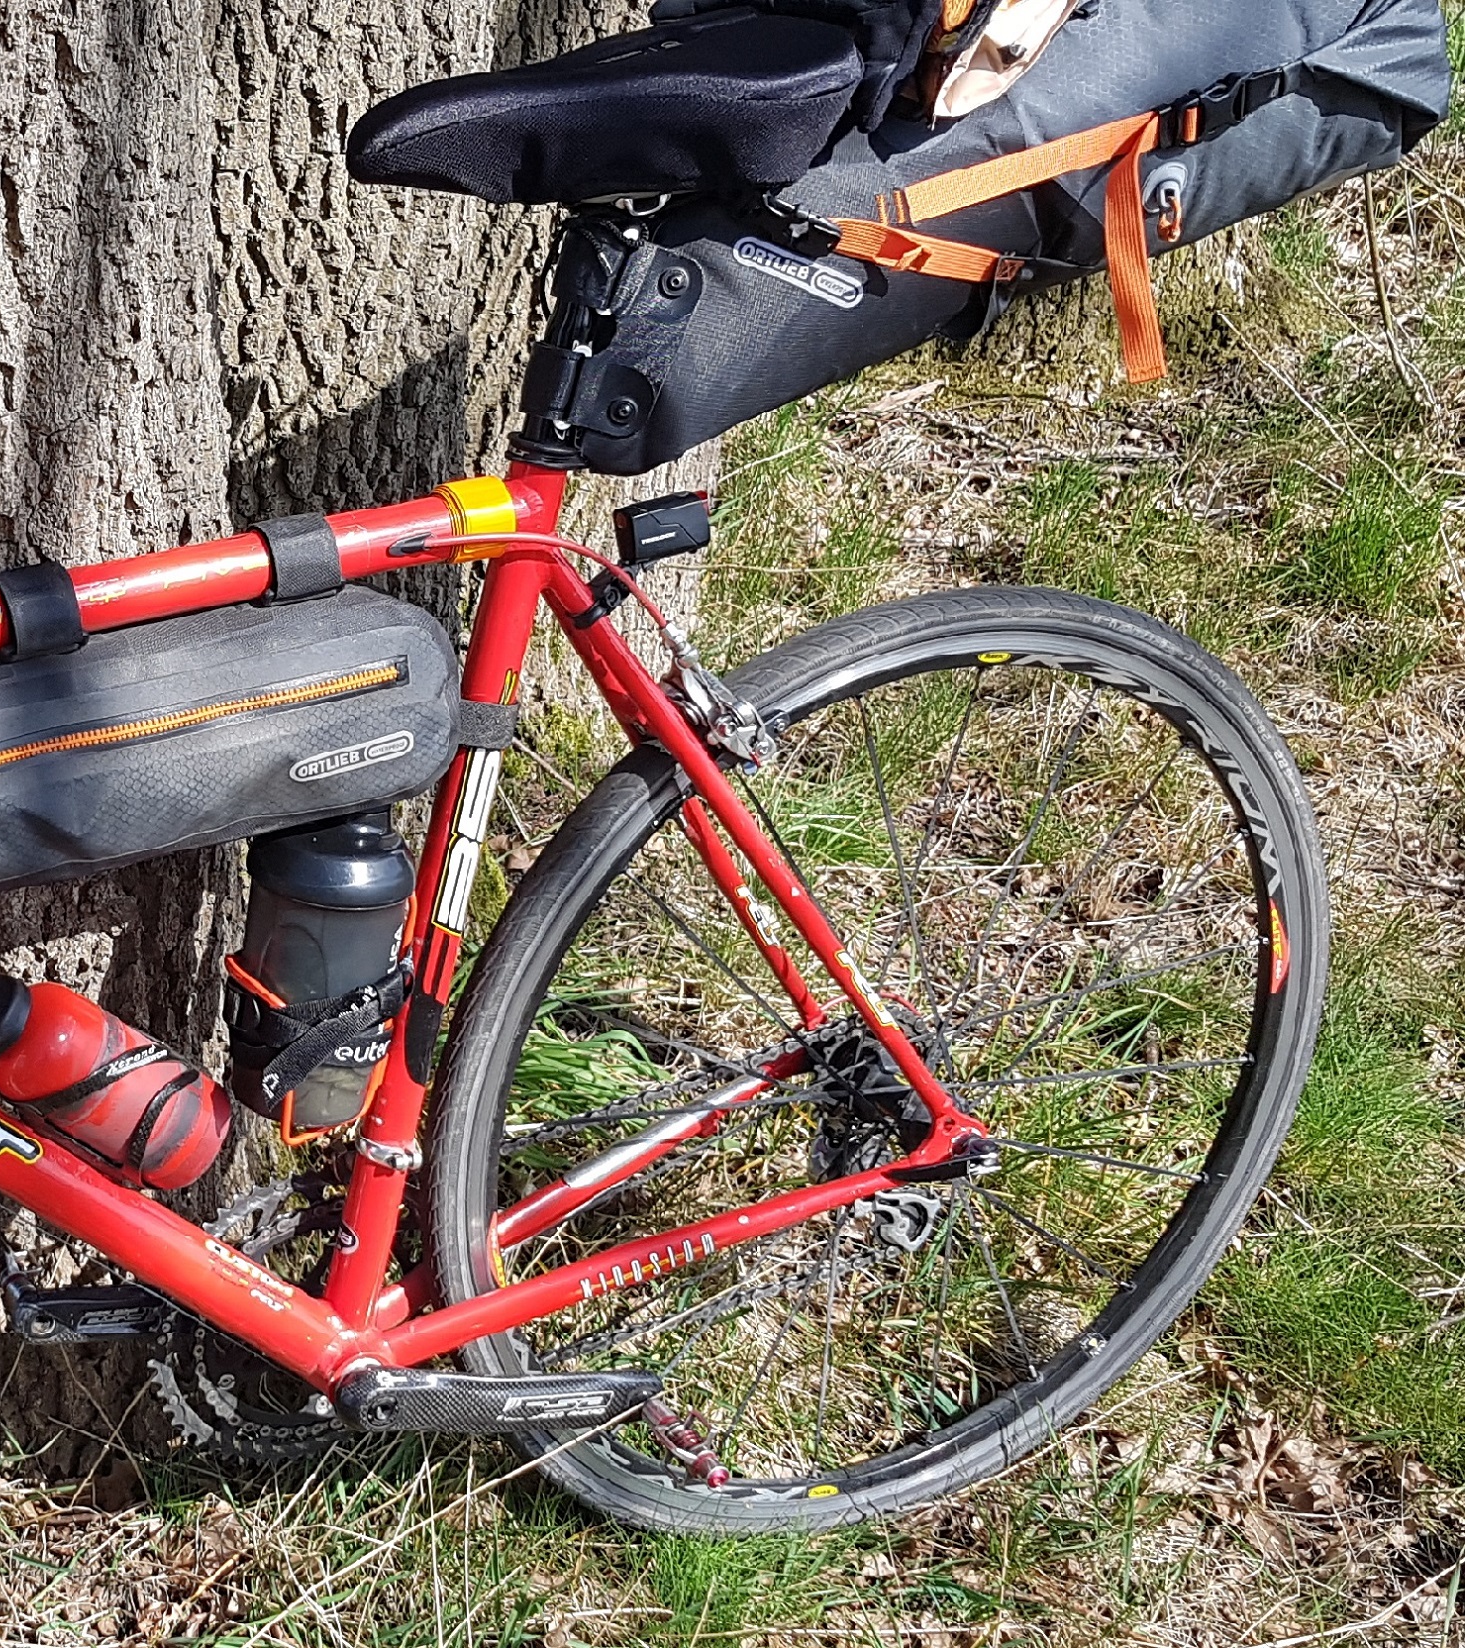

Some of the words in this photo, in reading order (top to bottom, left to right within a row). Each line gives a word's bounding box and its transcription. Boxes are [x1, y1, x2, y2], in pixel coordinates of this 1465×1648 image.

[740, 243, 809, 280] ORTLIEB
[297, 751, 360, 777] ORTLIEB
[335, 1040, 390, 1061] euter
